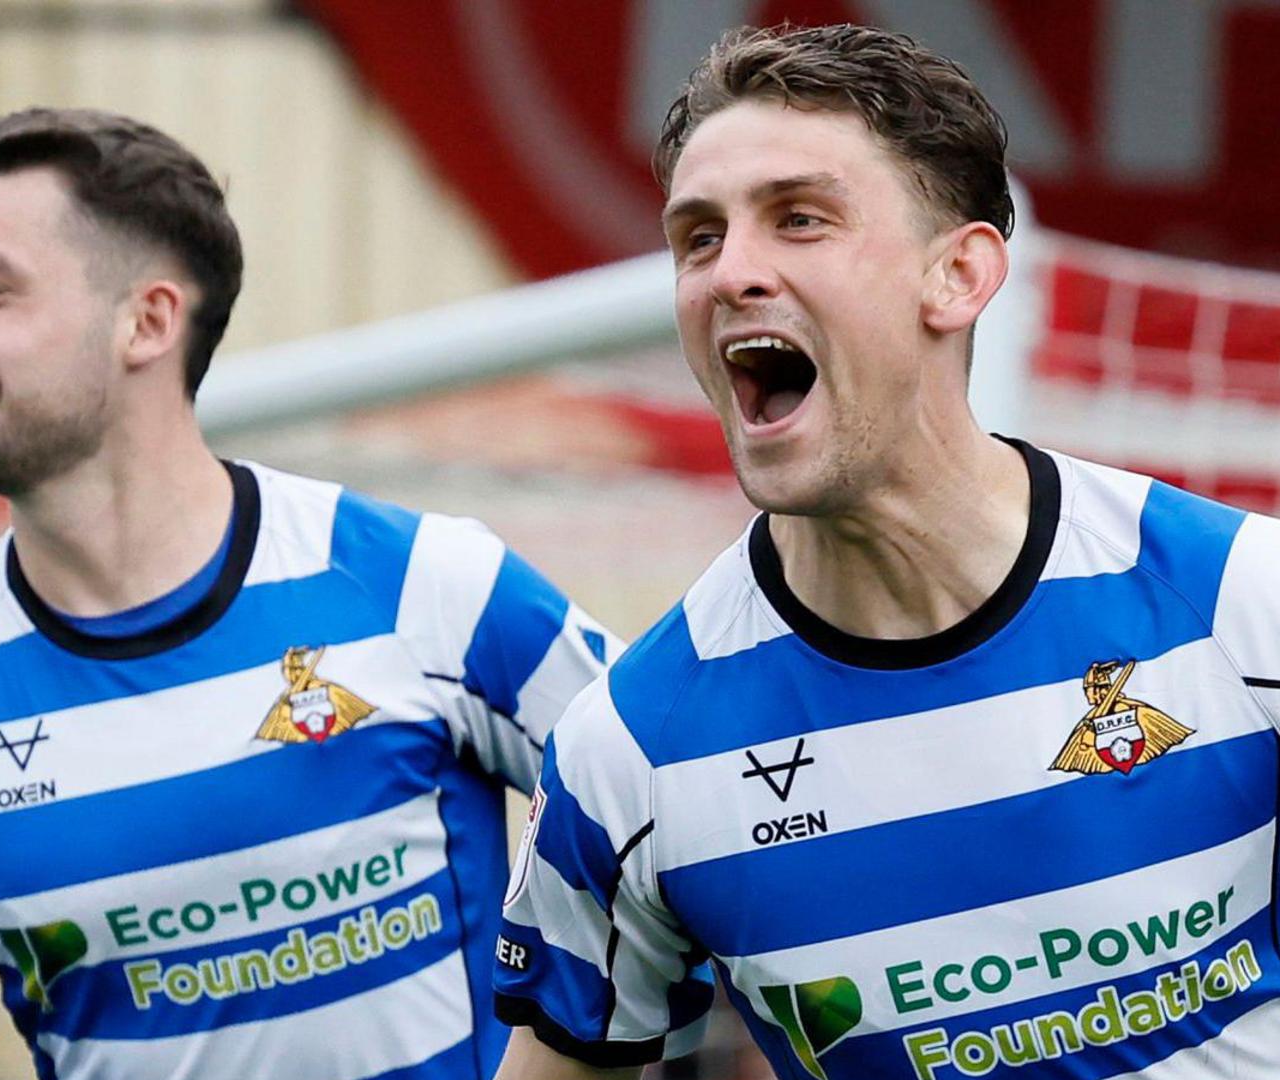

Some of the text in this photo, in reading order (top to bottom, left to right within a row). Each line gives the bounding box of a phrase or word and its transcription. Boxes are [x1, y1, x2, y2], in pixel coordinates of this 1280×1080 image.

[752, 810, 827, 845] OXEN
[106, 842, 410, 946] Eco-Power
[127, 894, 442, 1010] Foundation
[885, 886, 1235, 1014] Eco-Power
